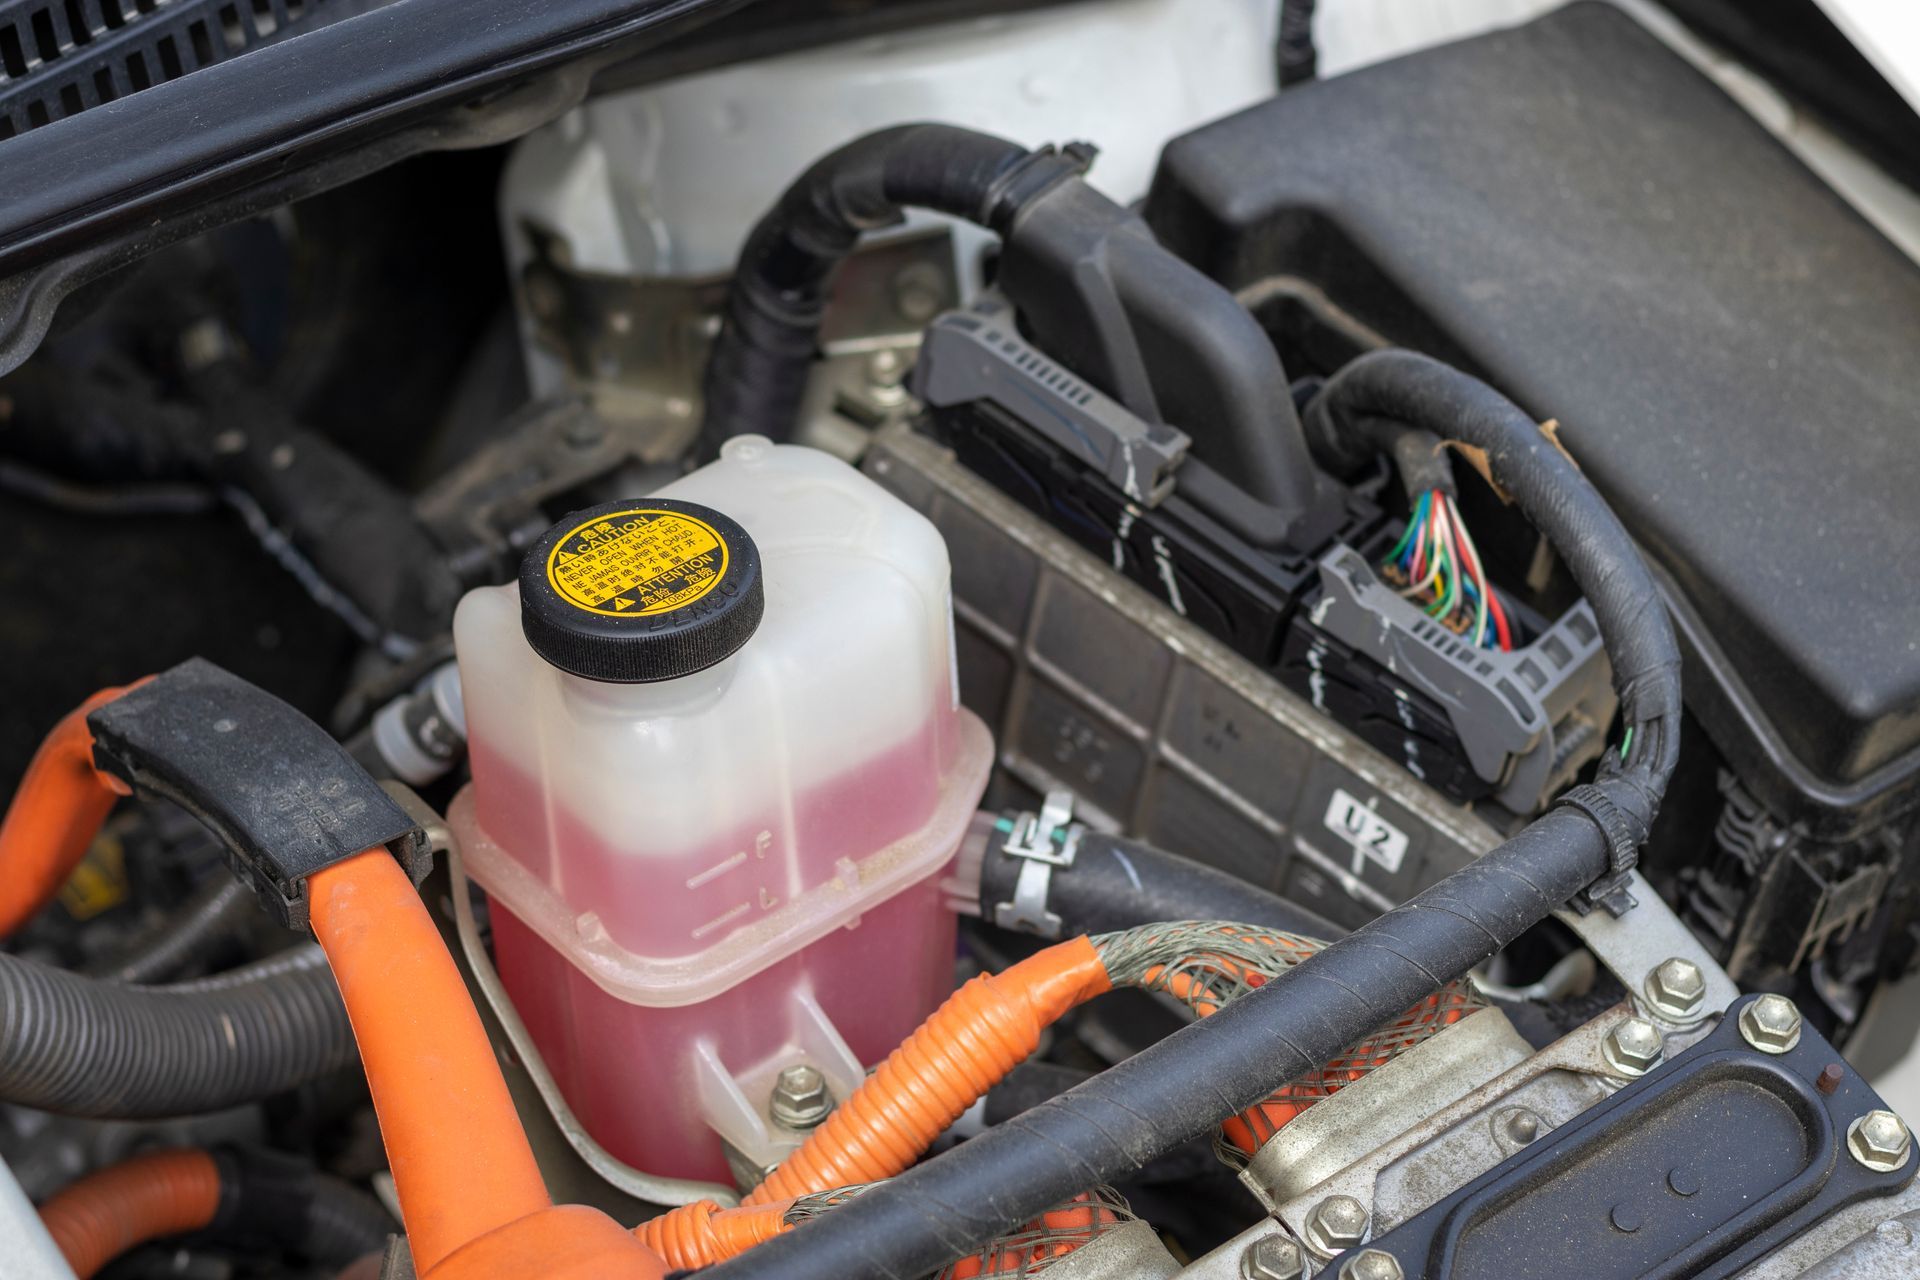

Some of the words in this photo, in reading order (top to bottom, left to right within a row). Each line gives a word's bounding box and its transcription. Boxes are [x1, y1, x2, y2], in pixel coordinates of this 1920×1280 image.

[577, 516, 649, 553] CAUTION
[563, 564, 597, 583] NEVER
[600, 550, 627, 566] OPEN
[629, 535, 659, 551] WHEN
[572, 581, 587, 591] NE
[589, 564, 620, 584] JAMAIS
[620, 548, 653, 567] OUVRIR
[637, 553, 714, 595] ATTENTION
[649, 582, 739, 632] DENSO
[663, 585, 704, 606] 108kPa
[756, 830, 772, 859] F
[759, 886, 779, 911] L
